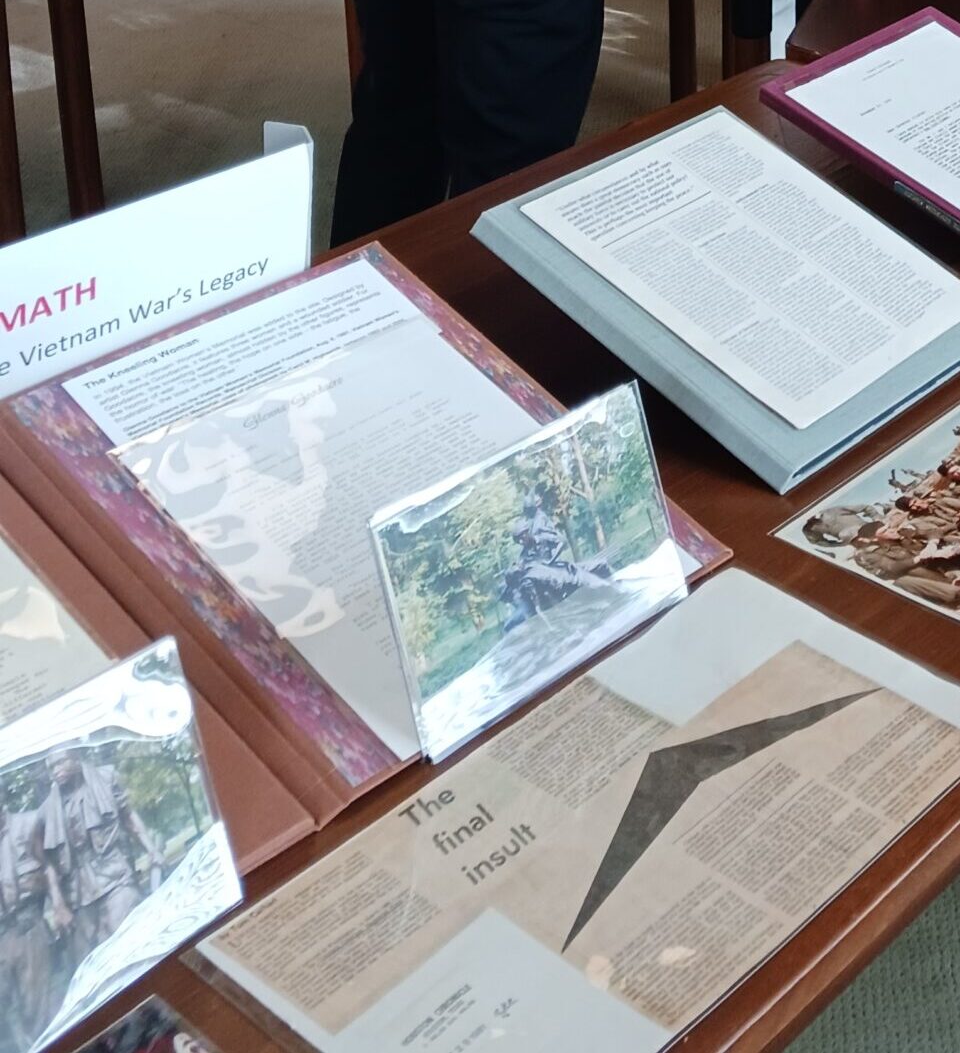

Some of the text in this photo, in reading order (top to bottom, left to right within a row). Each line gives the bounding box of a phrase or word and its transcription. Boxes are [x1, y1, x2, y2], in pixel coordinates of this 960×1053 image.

[0, 277, 97, 333] MATH
[19, 316, 120, 368] Vietnam
[128, 286, 193, 325] War’s
[199, 258, 269, 296] Legacy
[84, 338, 200, 389] The Kneeling Woman
[398, 789, 455, 827] The
[432, 803, 495, 855] final
[461, 822, 537, 886] insult
